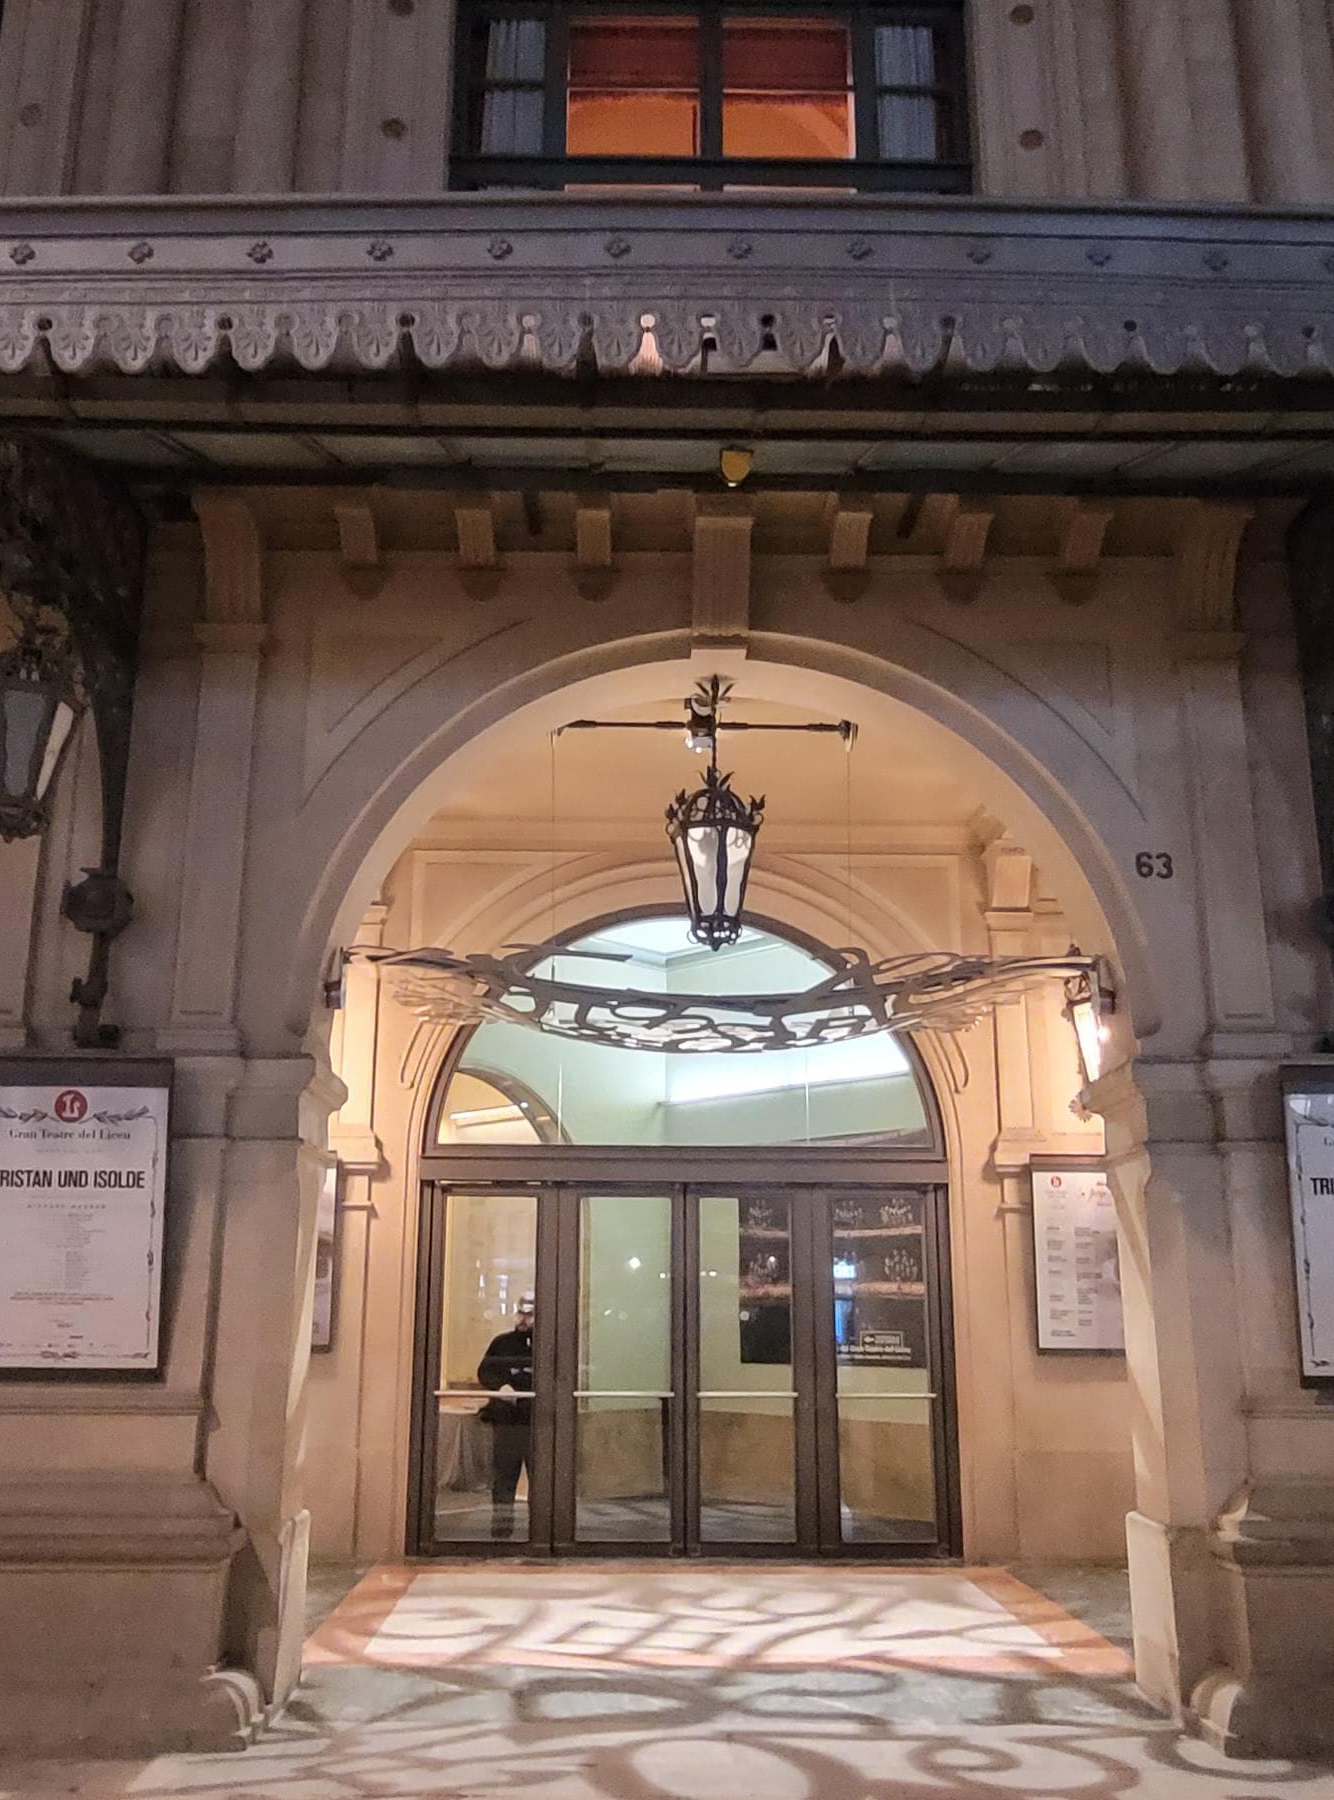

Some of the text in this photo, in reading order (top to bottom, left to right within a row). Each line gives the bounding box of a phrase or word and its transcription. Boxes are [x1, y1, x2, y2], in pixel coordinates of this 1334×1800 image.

[1136, 851, 1173, 879] 63
[78, 1129, 96, 1139] del
[58, 1170, 89, 1188] UND
[94, 1170, 145, 1189] ISOLDE
